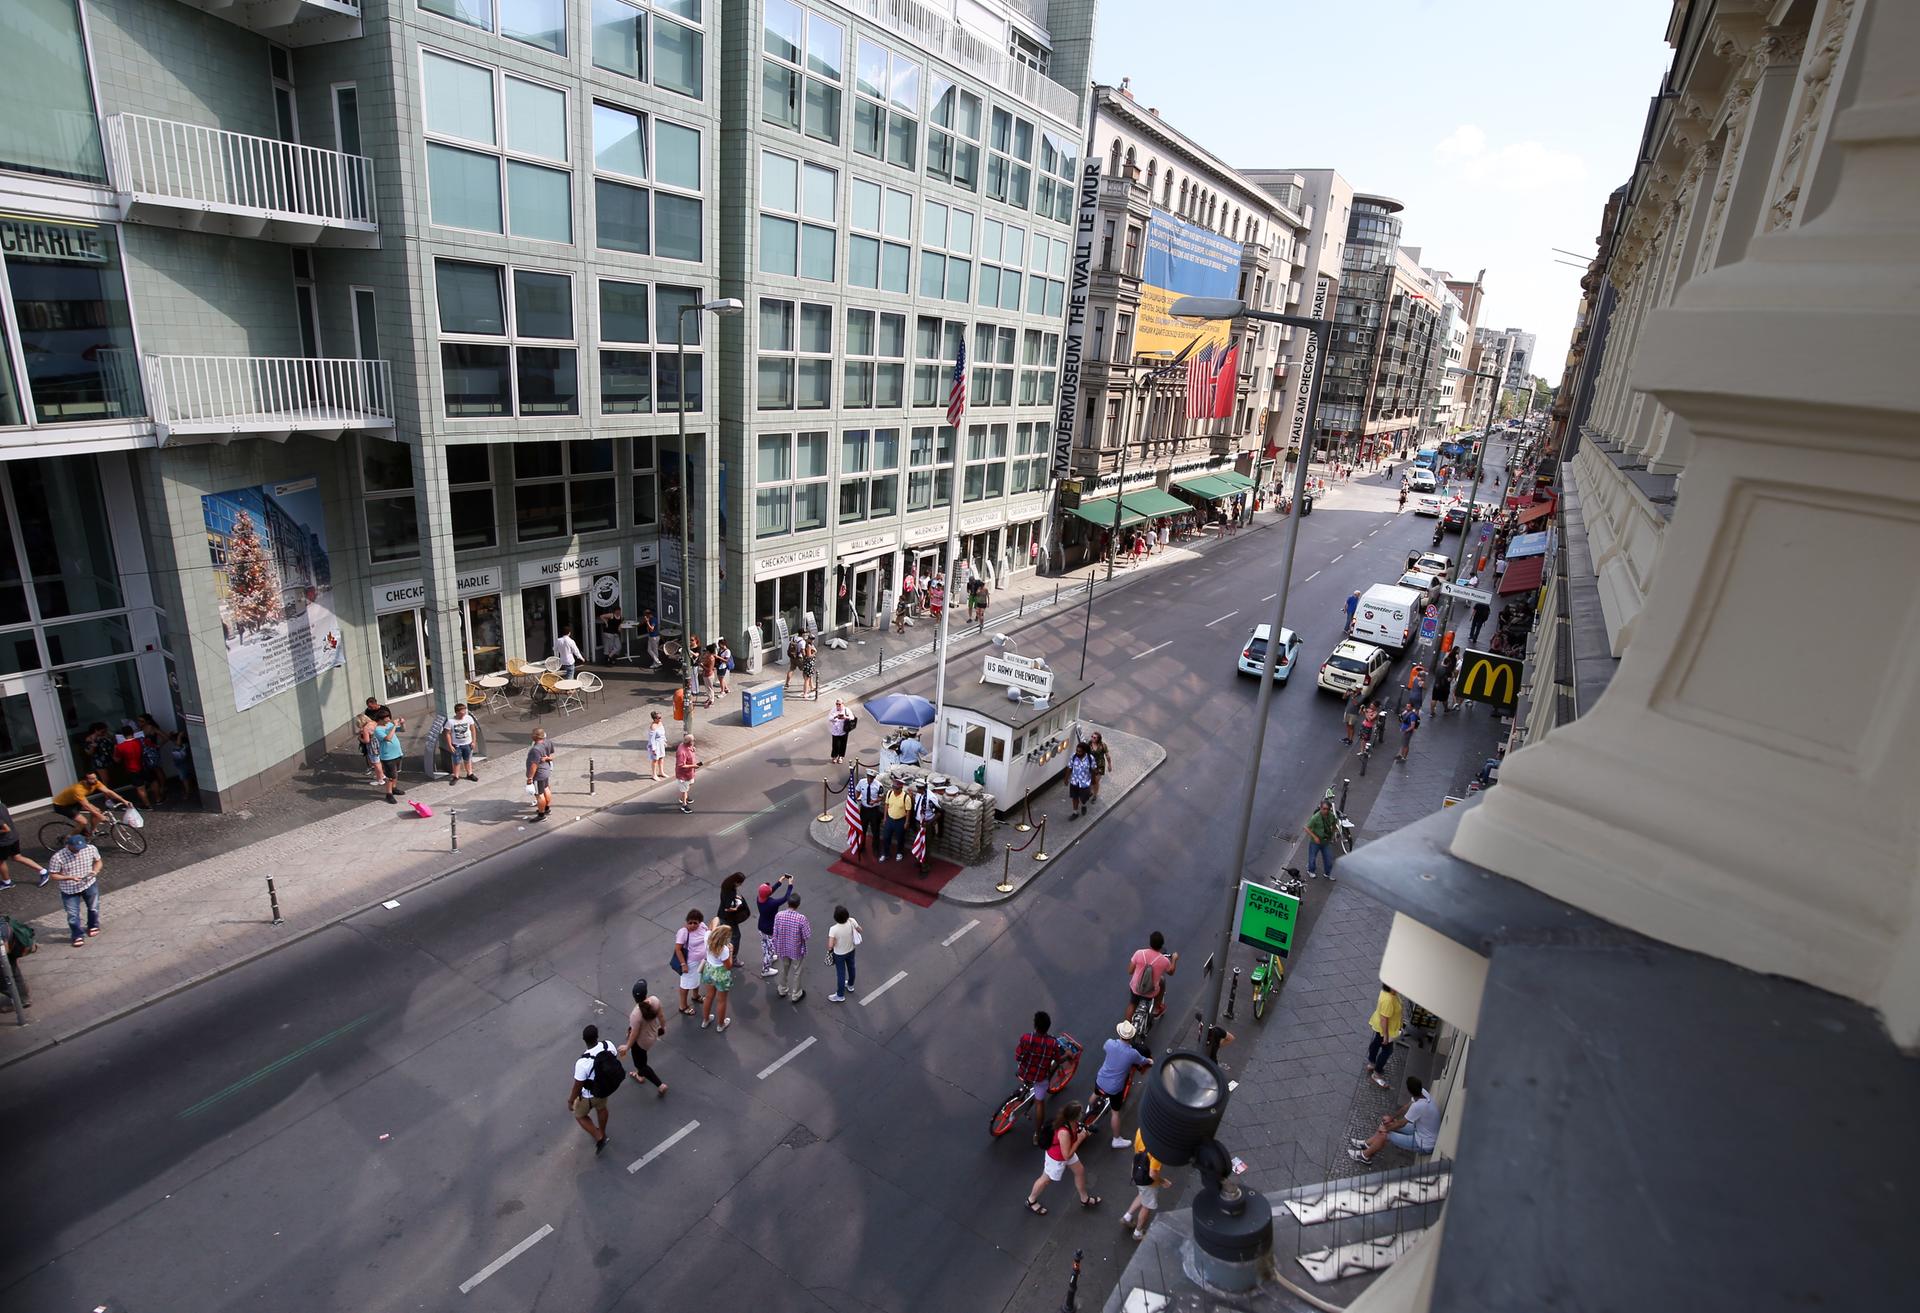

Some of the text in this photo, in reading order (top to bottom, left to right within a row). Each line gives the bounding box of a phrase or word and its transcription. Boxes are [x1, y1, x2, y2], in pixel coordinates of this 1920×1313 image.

[0, 220, 98, 257] CHARLIE
[1056, 164, 1101, 472] MAUERMUSEUM THE WALL LE MUR
[1300, 333, 1318, 394] CHECKPOIN
[1296, 397, 1307, 414] AM
[1291, 416, 1304, 443] HAUS
[541, 556, 599, 575] MUSEUMSCAFE
[761, 548, 821, 568] CHECKPOINT CHARLIE
[457, 575, 490, 590] HARLIE
[987, 662, 1048, 686] US ARMY CHECKPOINT
[1251, 893, 1289, 912] CAPITAL
[1264, 906, 1289, 921] SPIES
